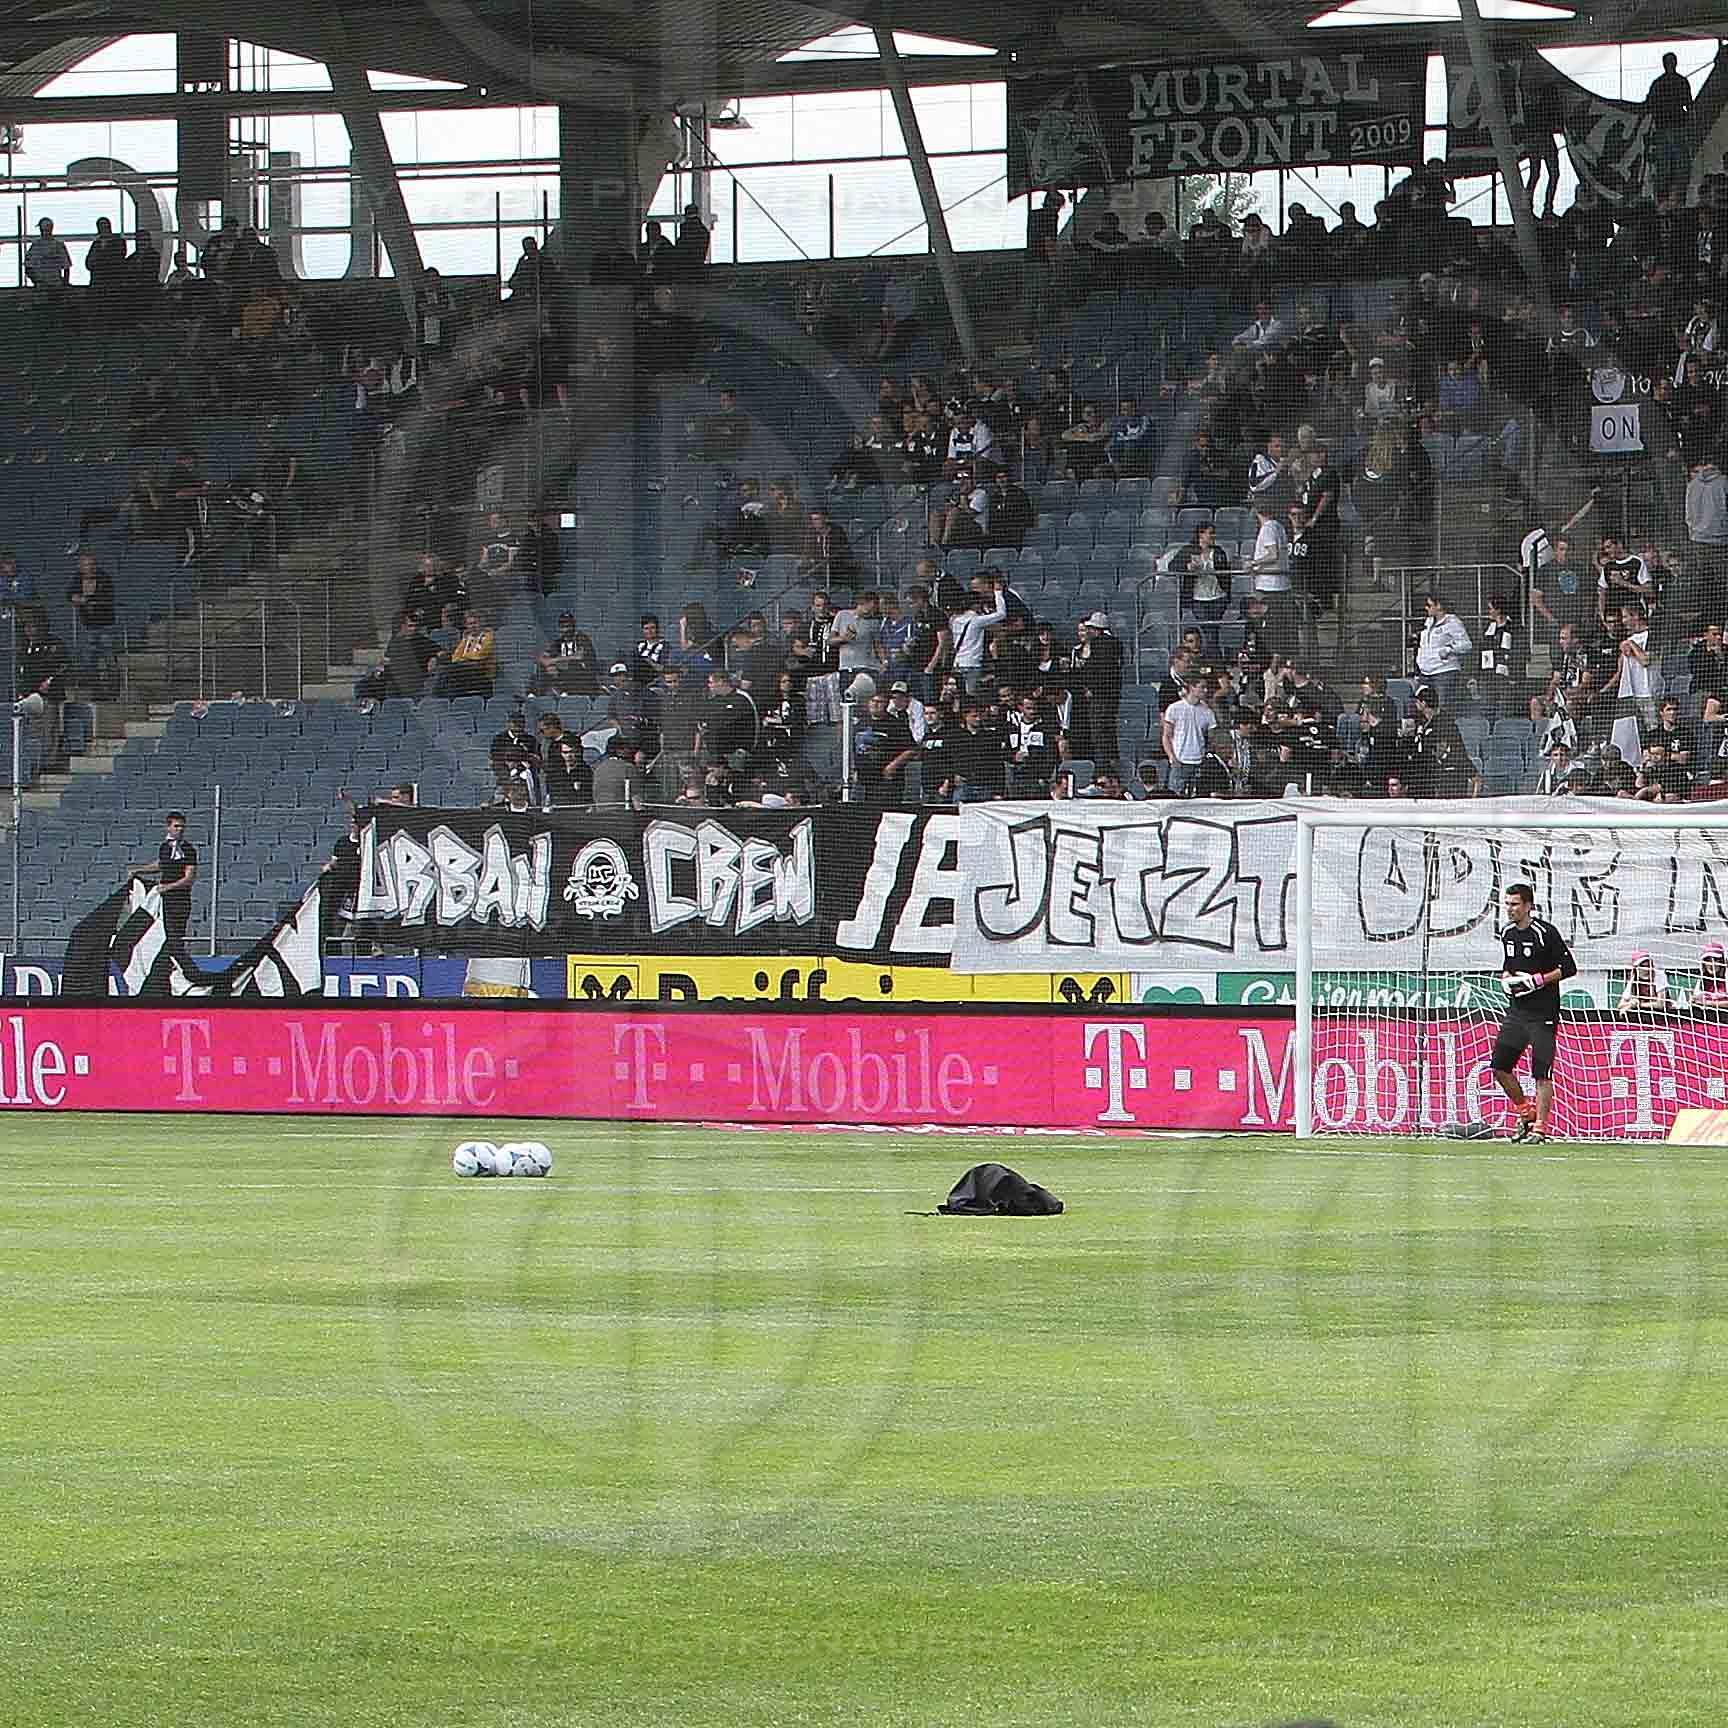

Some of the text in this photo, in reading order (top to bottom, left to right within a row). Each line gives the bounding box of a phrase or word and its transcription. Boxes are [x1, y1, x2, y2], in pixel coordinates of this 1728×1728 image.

[1128, 54, 1379, 121] MURTAL
[1127, 110, 1411, 177] FRONT 2009
[354, 815, 815, 936] URBAN CREW
[975, 813, 1299, 952] JETZT
[1359, 824, 1622, 944] ODER
